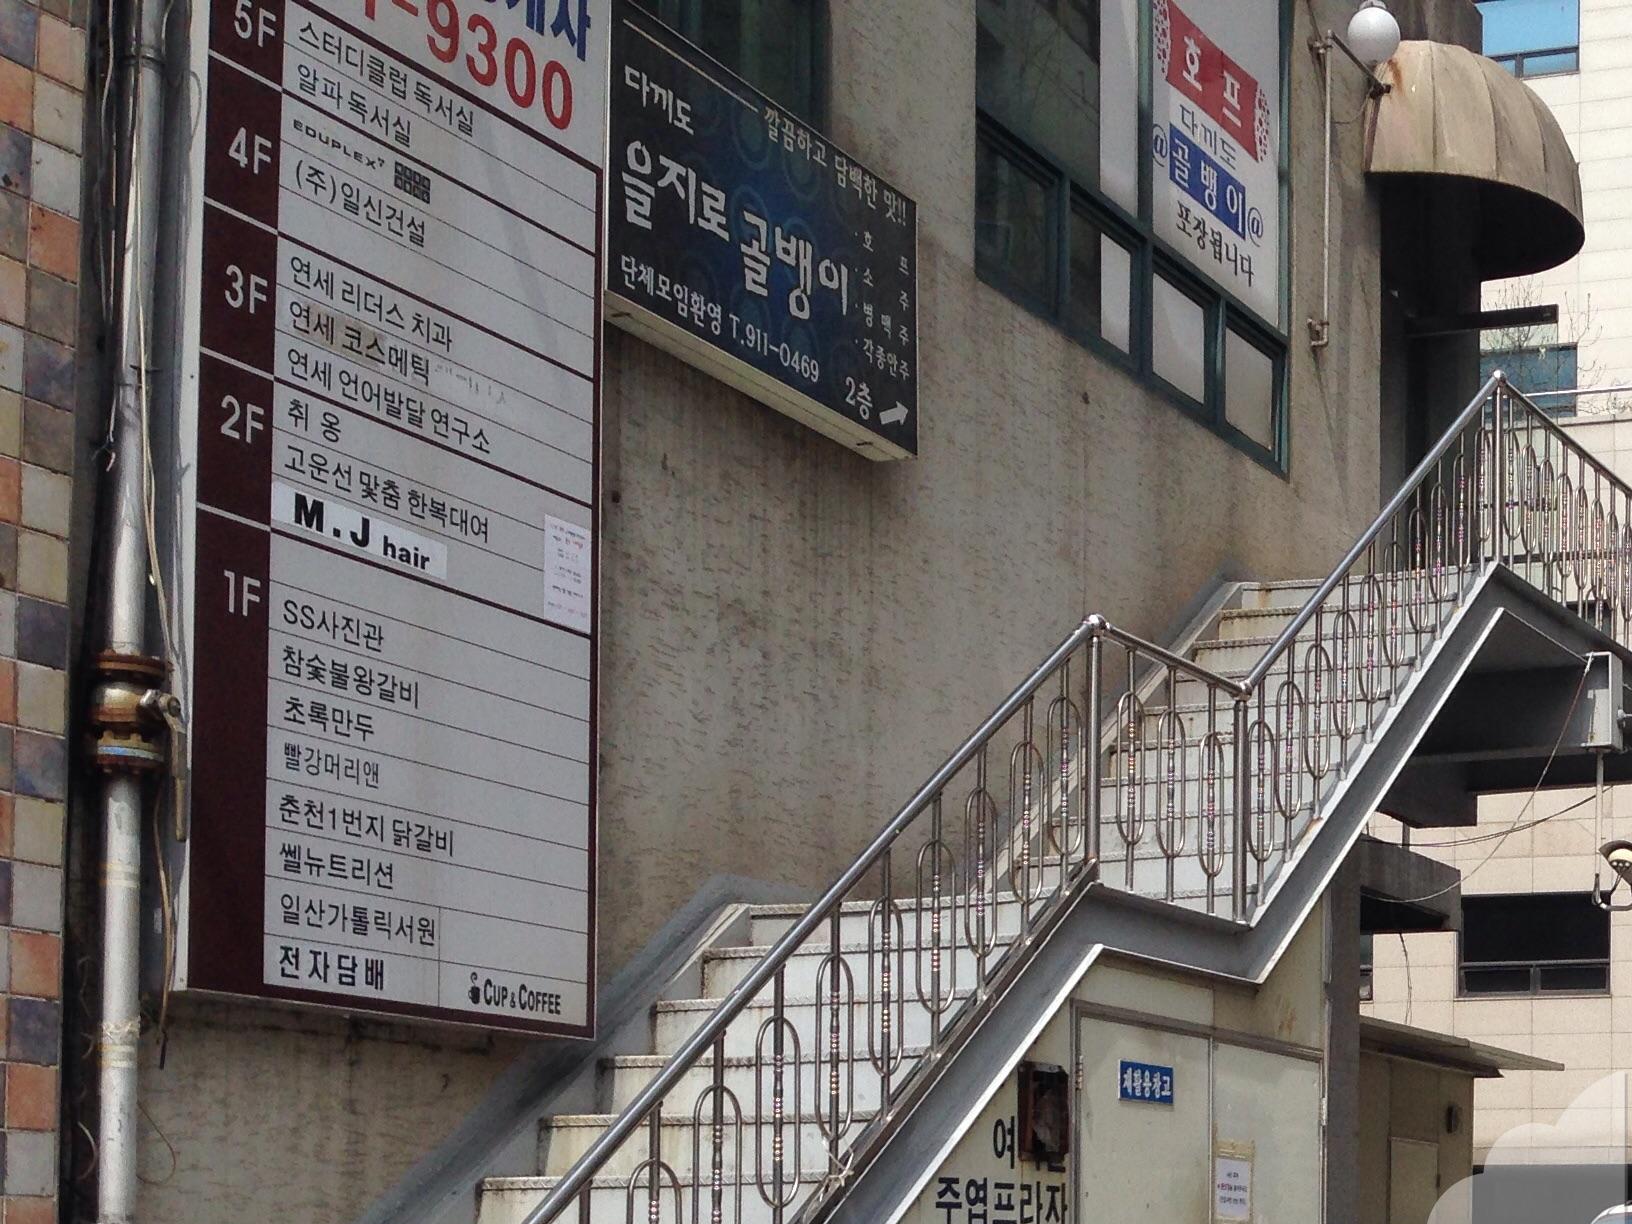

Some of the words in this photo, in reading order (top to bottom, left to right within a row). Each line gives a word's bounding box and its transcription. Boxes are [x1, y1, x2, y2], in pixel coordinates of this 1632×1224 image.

[234, 0, 277, 47] 5F
[298, 64, 343, 109] 알파
[348, 91, 412, 148] 독서실
[299, 22, 408, 100] 스터디클럽
[414, 81, 474, 137] 독서실
[624, 64, 694, 136] 다끼도
[228, 127, 272, 174] 4F
[764, 106, 827, 167] 깔끔하고
[835, 155, 878, 210] 담백한
[1179, 103, 1237, 170] 다끼도
[296, 160, 426, 247] (주)일신건설
[1173, 138, 1243, 232] 골뱅이
[622, 140, 730, 242] 을지로
[740, 210, 849, 320] 골뱅이
[1176, 199, 1255, 287] 포장됩니다
[224, 265, 268, 314] 3F
[290, 256, 334, 300] 연세
[342, 280, 406, 330] 리더스
[412, 312, 452, 352] 치과
[620, 254, 722, 336] 단체모임환영
[729, 313, 820, 383] T.911-0469
[289, 301, 334, 345] 연세
[342, 326, 429, 387] 코스메틱
[220, 395, 265, 444] 2F
[288, 348, 332, 391] 연세
[339, 370, 426, 430] 언어발달
[431, 408, 491, 454] 연구소
[844, 376, 873, 421] 2층
[284, 445, 352, 493] 고운선
[407, 489, 489, 543] 한복대여
[383, 536, 431, 571] hair
[223, 570, 261, 617] 1F
[283, 599, 385, 652] SS사진관
[283, 645, 419, 710] 참숯불왕갈비
[284, 696, 375, 741] 초록만두
[284, 742, 379, 789] 빨강머리앤
[279, 794, 384, 842] 춘천1번지
[392, 819, 454, 857] 닭갈비
[280, 843, 393, 890] 쎌뉴트리션
[280, 893, 435, 946] 일산가톨릭서원
